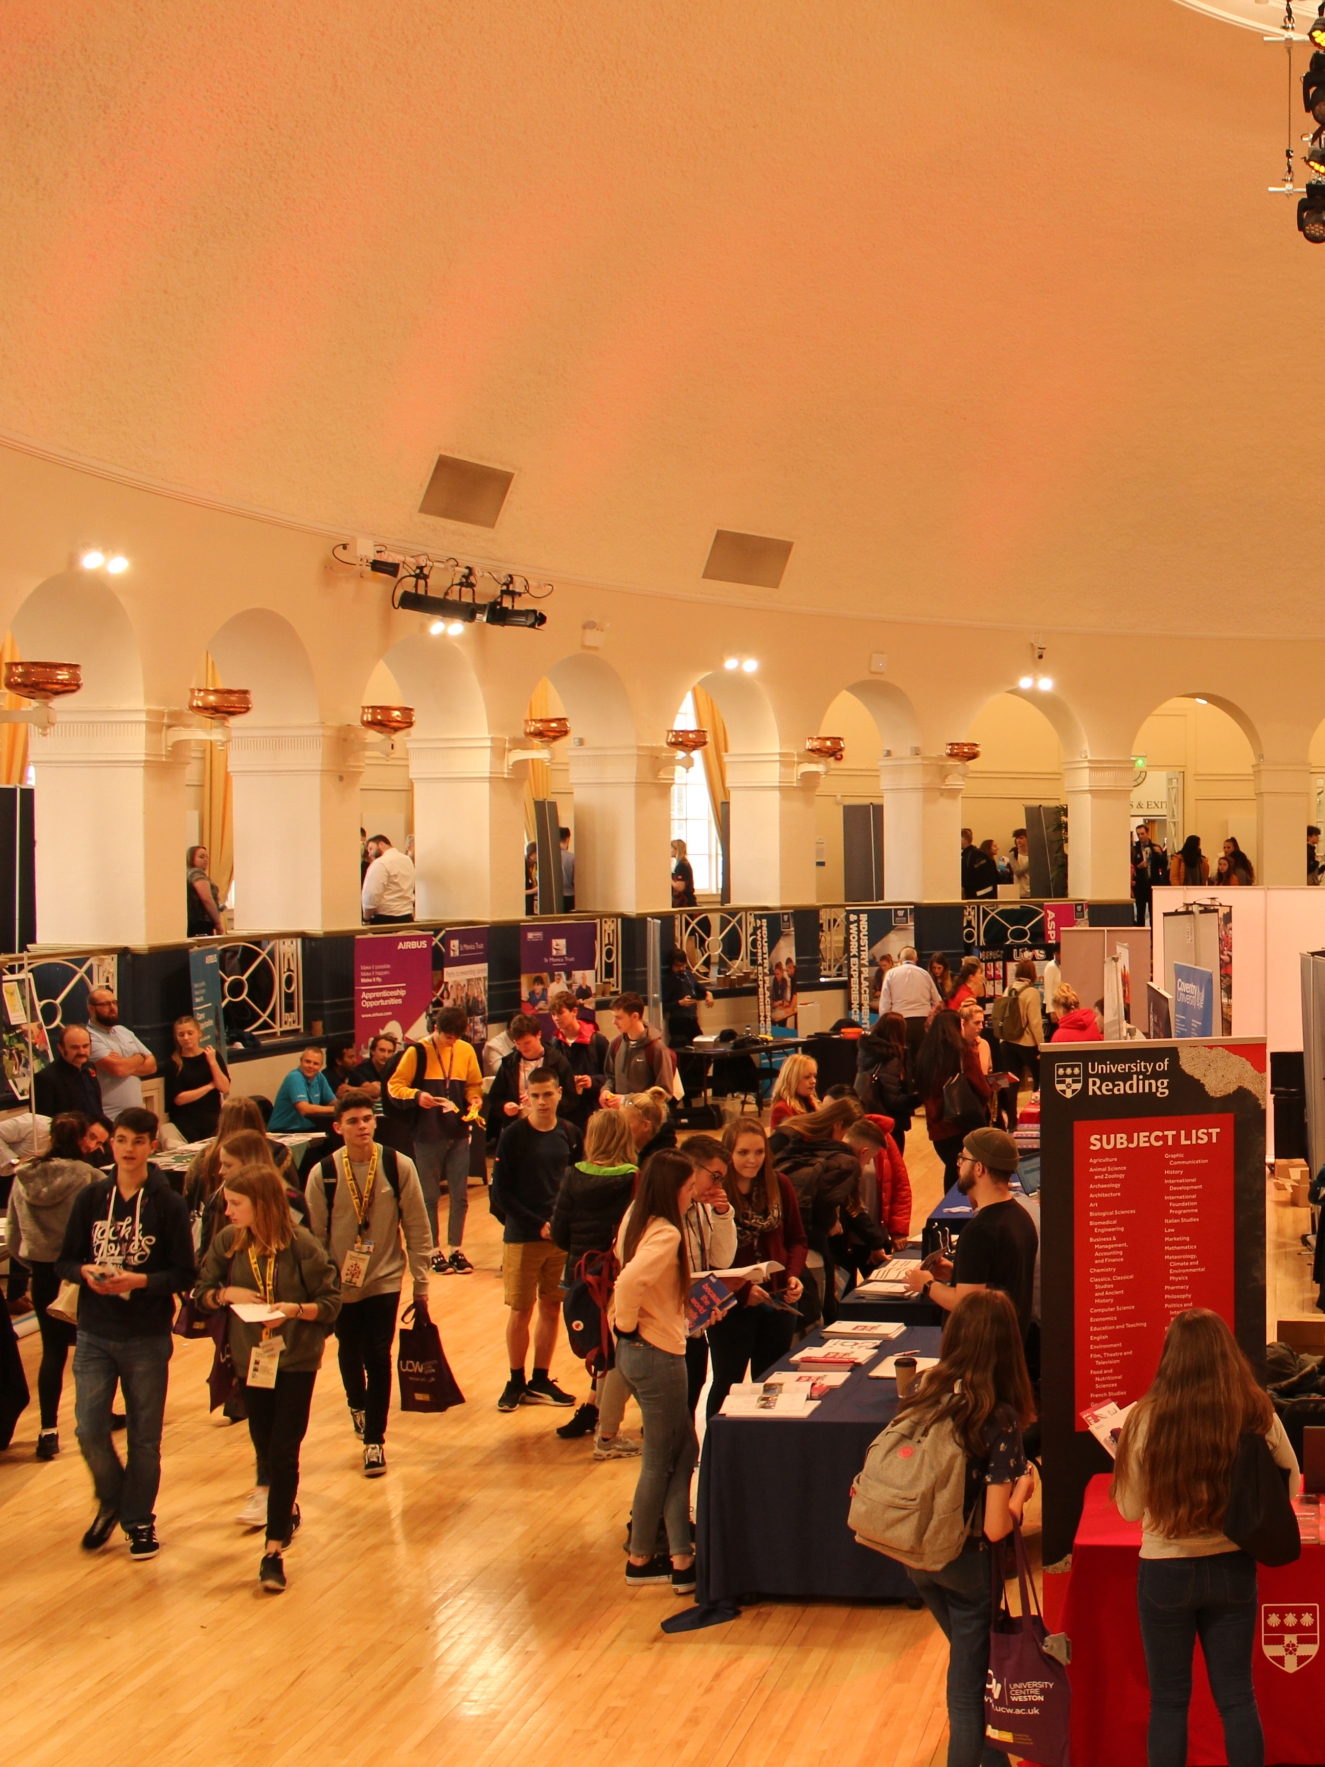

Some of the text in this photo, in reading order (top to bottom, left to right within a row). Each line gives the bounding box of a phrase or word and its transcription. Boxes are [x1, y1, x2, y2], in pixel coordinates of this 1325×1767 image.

[397, 940, 428, 950] AIRBUS
[475, 942, 484, 950] Trust
[859, 914, 869, 967] INDUSTRY
[849, 914, 860, 1022] & WORK EXPERIENCE
[361, 988, 407, 1000] Apprenticeship
[1177, 978, 1197, 998] Coventry
[362, 997, 402, 1009] Opportunities
[861, 967, 871, 1031] PLACEMENT
[1177, 991, 1196, 1009] University
[1088, 1058, 1170, 1076] University of
[1088, 1075, 1170, 1098] Reading
[1089, 1128, 1221, 1151] SUBJECT LIST
[1165, 1152, 1184, 1160] Graphic
[1105, 1172, 1125, 1180] Zoology
[1089, 1182, 1121, 1190] Archaeology
[1089, 1191, 1121, 1199] Architecture
[1094, 1226, 1125, 1234] Engineering
[1094, 1250, 1123, 1258] Accounting
[1009, 1681, 1054, 1690] UNIVERSITY
